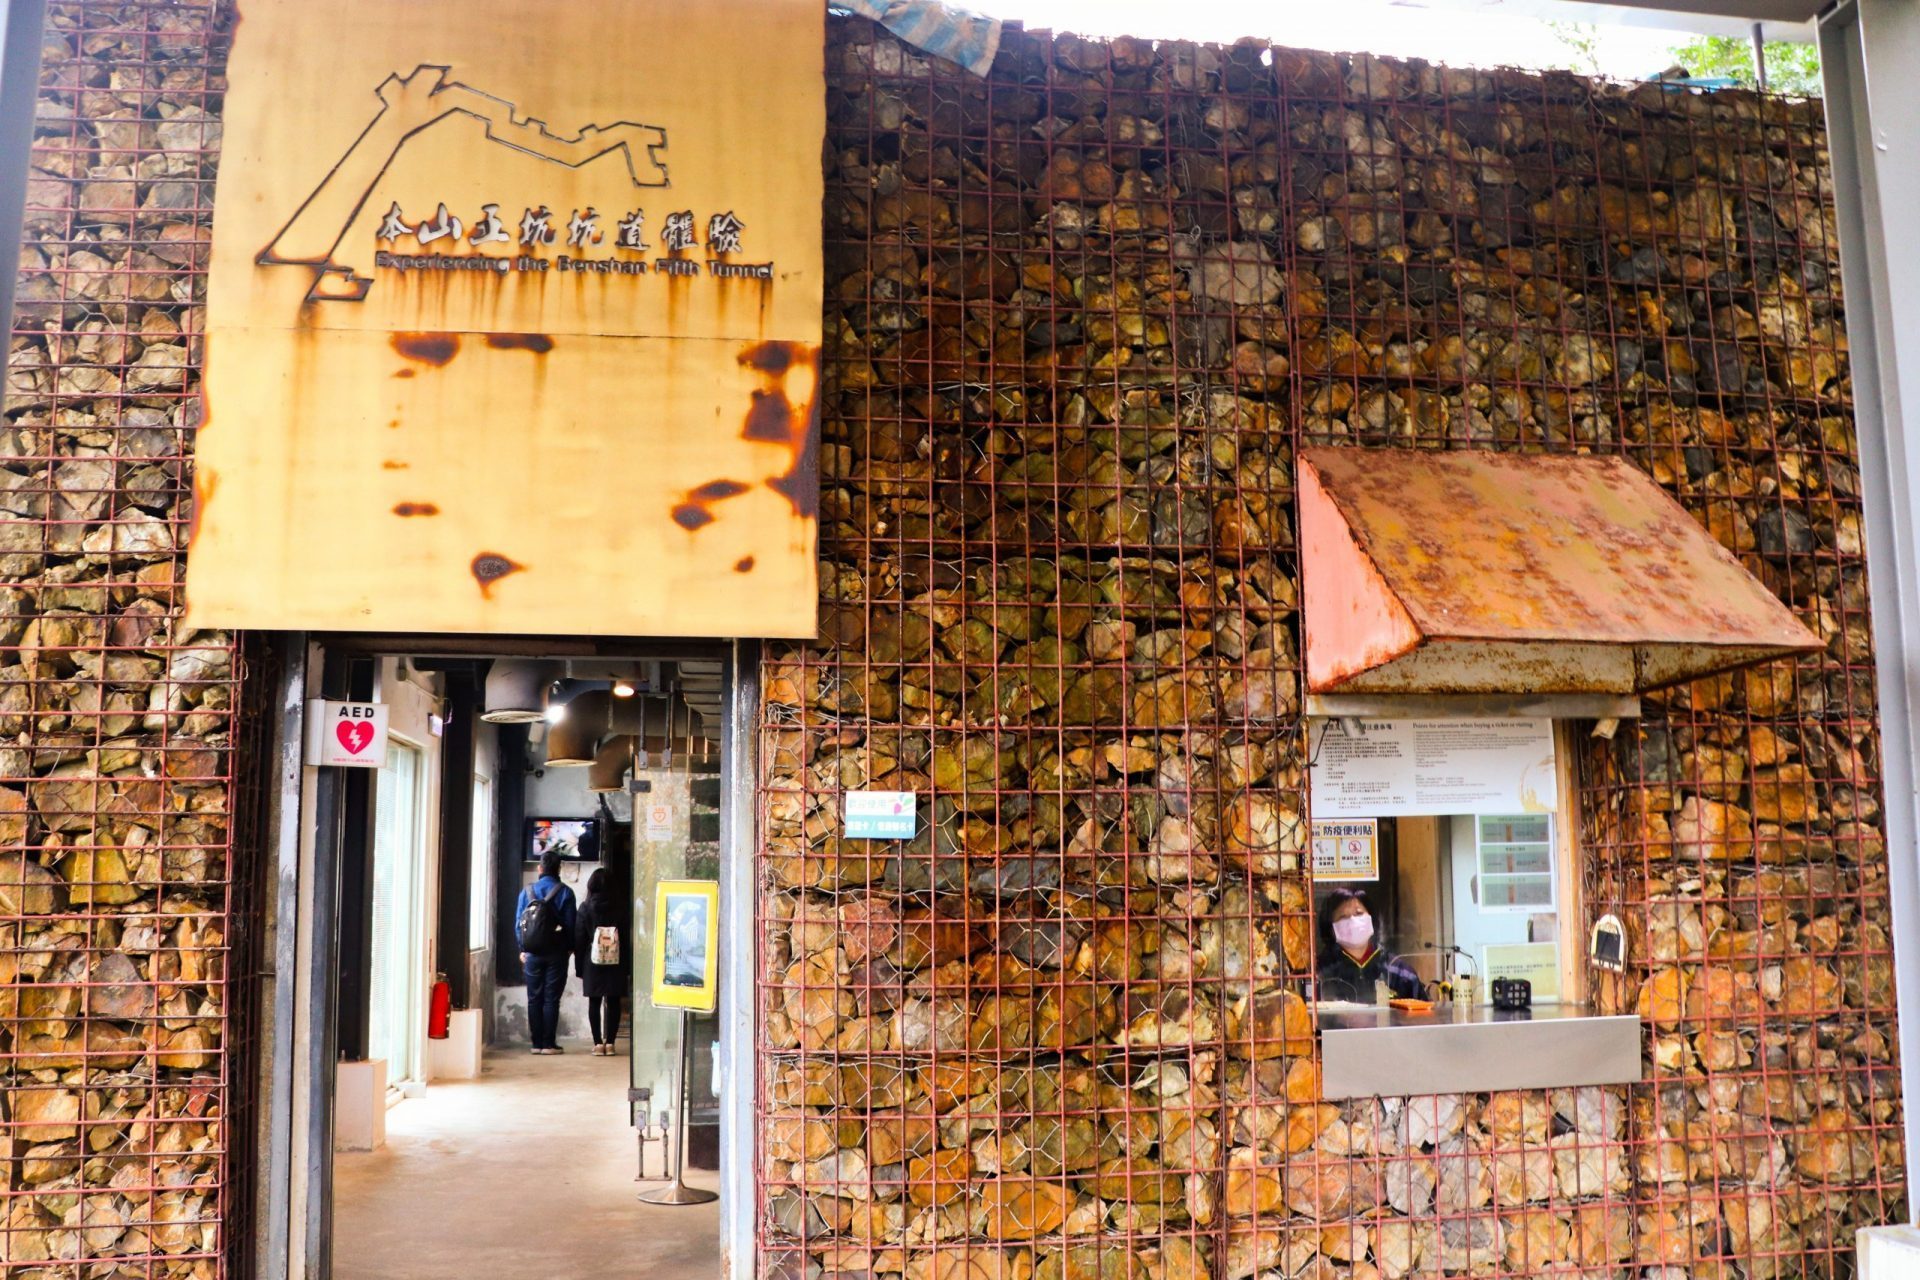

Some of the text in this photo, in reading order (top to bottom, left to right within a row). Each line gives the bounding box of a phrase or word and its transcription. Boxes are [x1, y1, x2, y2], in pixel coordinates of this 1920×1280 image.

[376, 201, 747, 253] 本山五坑坑道體驗
[375, 251, 775, 280] Experiencing the Benshan Fifth Tunnel
[339, 706, 375, 718] AED
[1323, 825, 1373, 836] 防疫便利貼
